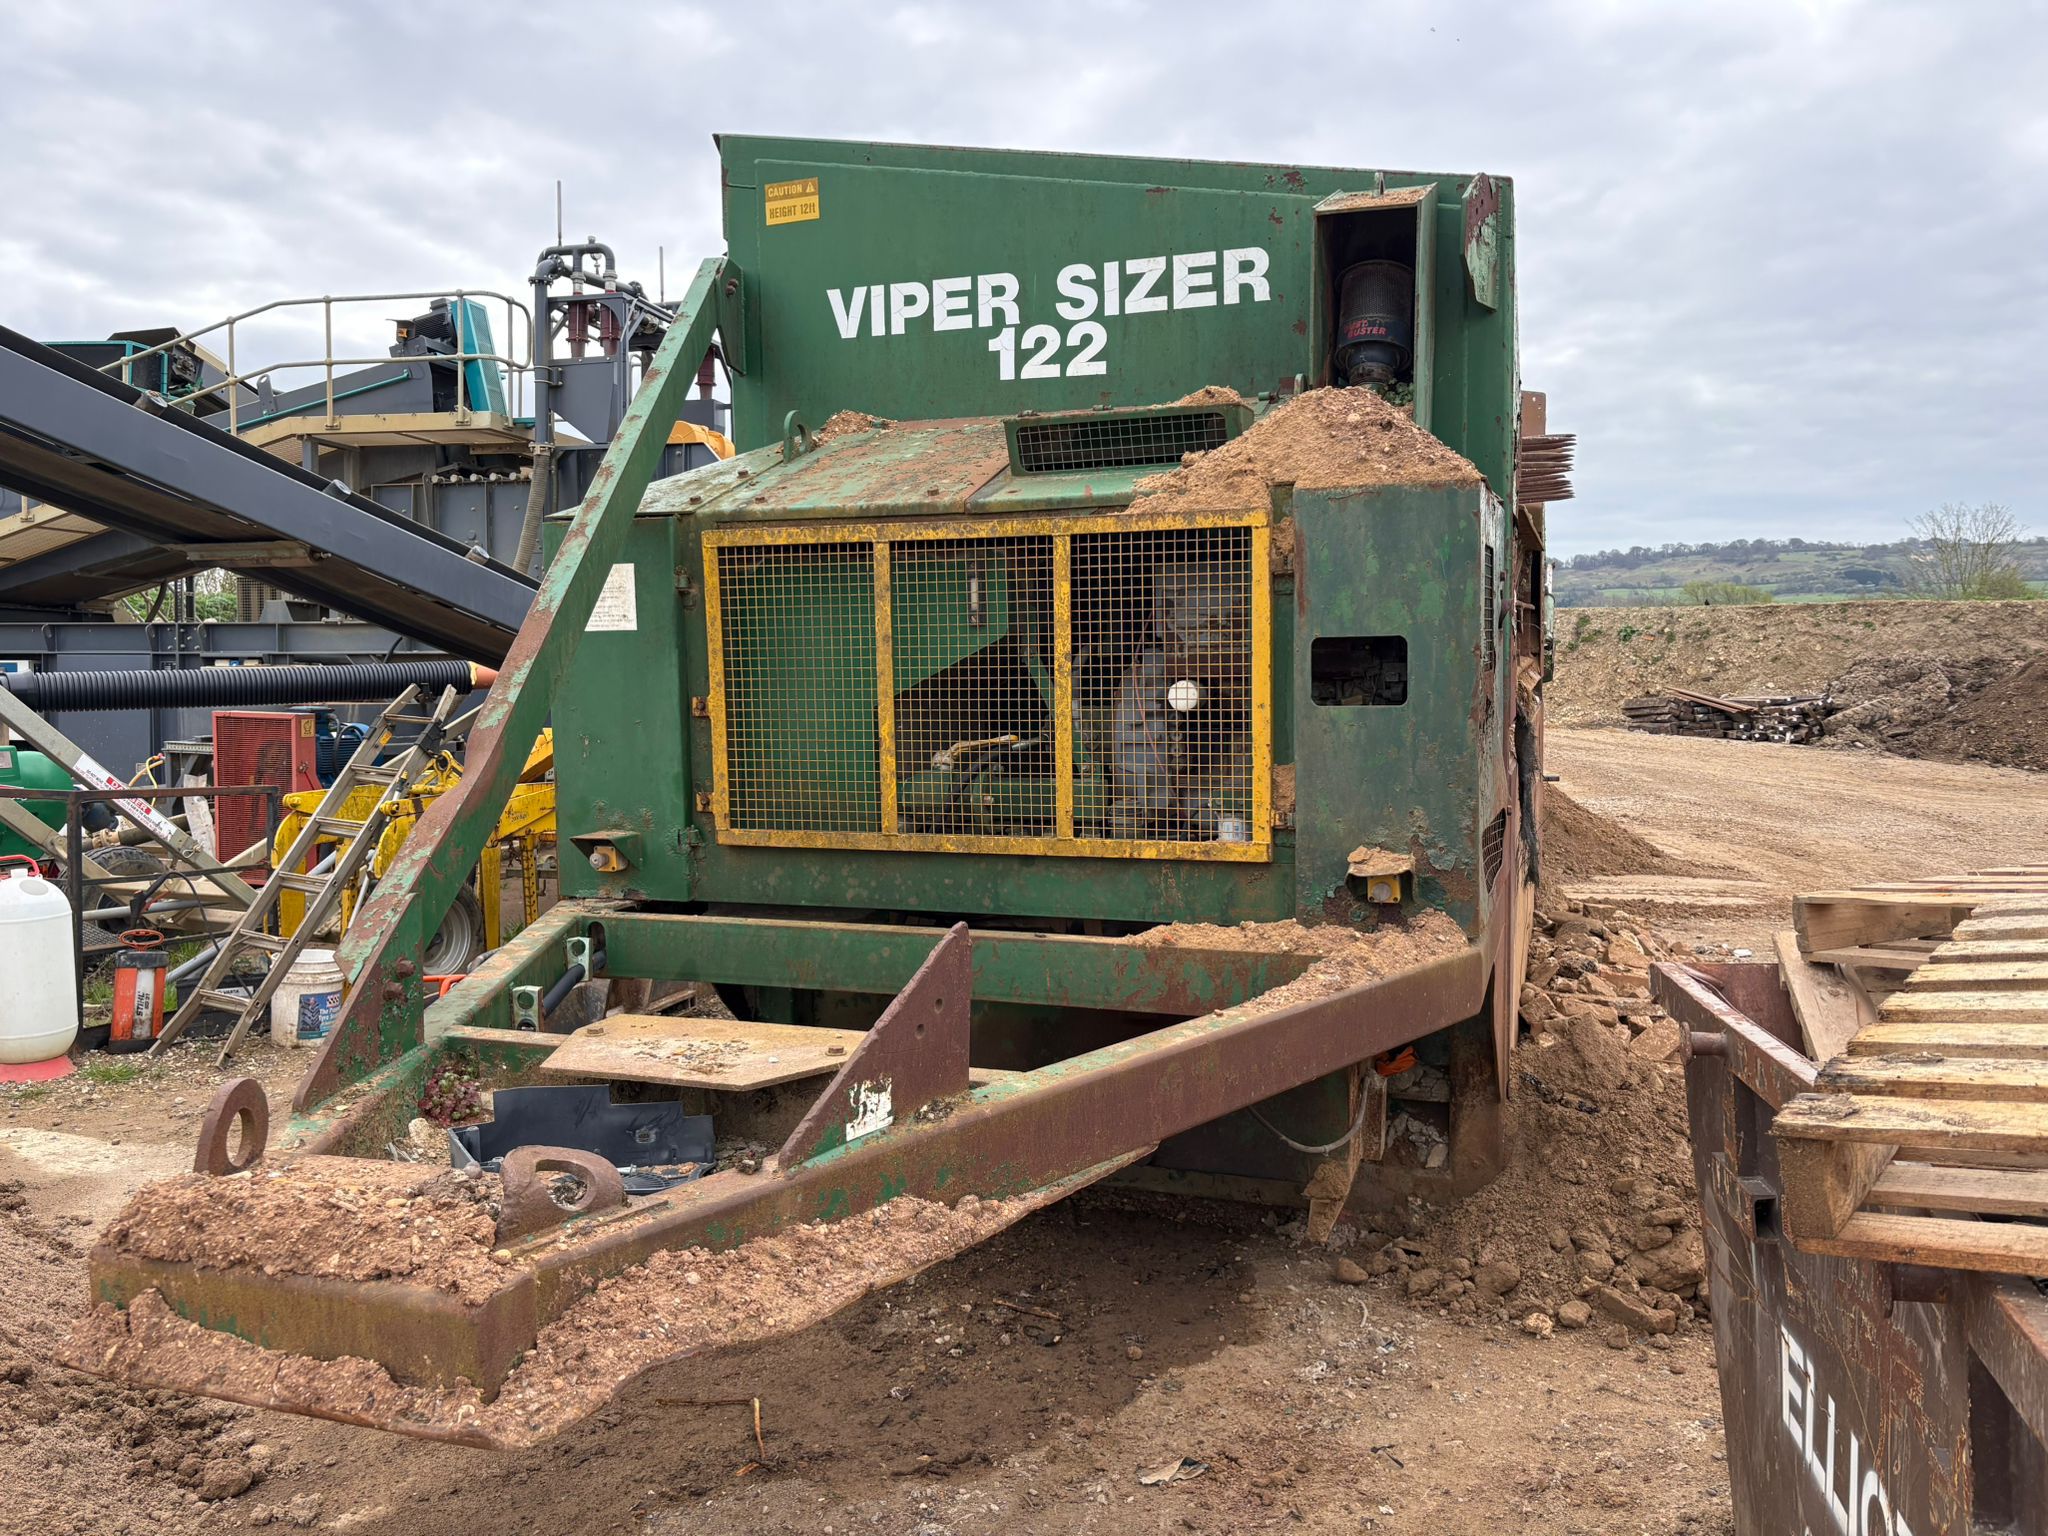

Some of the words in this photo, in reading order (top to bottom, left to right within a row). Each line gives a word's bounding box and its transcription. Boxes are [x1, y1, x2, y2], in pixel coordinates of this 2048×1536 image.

[768, 184, 802, 197] CAUTION
[769, 204, 797, 219] HEIGHT
[800, 202, 816, 215] 12ft
[826, 271, 1020, 339] VIPER
[1055, 246, 1271, 320] SIZER
[988, 320, 1108, 381] 122
[136, 991, 145, 1016] STIHL
